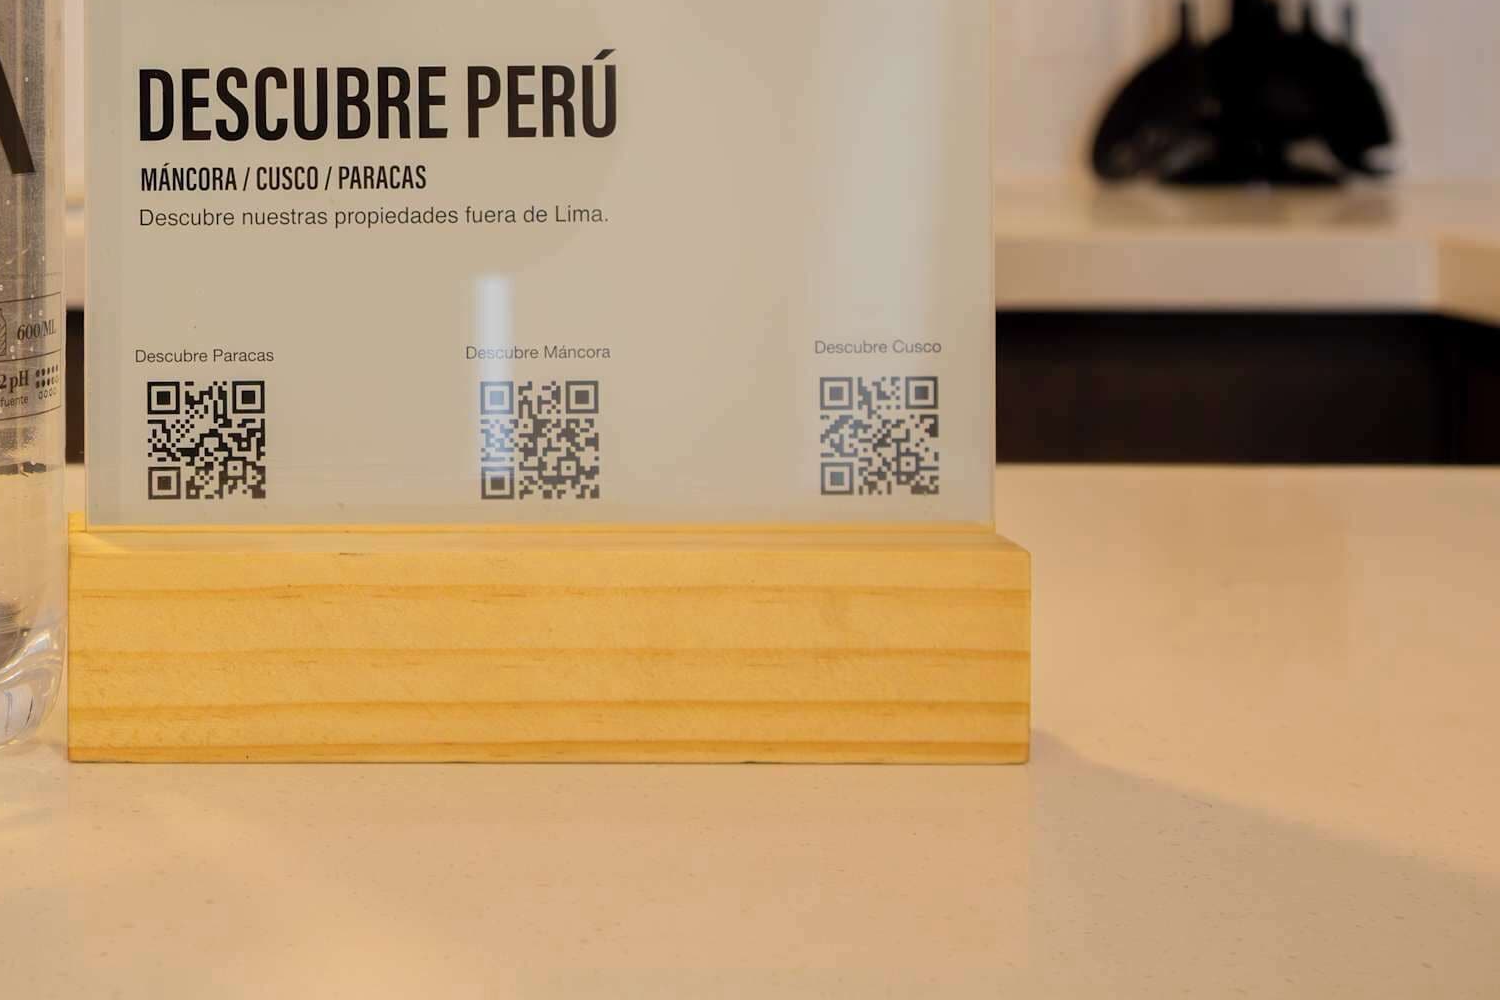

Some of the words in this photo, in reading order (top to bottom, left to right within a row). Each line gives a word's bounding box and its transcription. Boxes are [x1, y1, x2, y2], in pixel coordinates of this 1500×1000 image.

[139, 66, 449, 142] DESCUBRE
[467, 48, 617, 139] PERÚ
[140, 163, 237, 191] MÁNCORA
[256, 166, 319, 191] CUSCO
[338, 164, 427, 190] PARACAS
[139, 207, 235, 226] Descubre
[242, 208, 328, 226] nuestras
[334, 205, 459, 228] propiedades
[465, 205, 517, 224] fuera
[523, 205, 549, 223] de
[555, 204, 609, 223] Lima.
[16, 319, 57, 341] 600/ML
[134, 348, 208, 363] Descubre
[212, 347, 275, 363] Paracas
[465, 344, 539, 360] Descubre
[543, 343, 611, 359] Máncora
[814, 339, 888, 354] Descubre
[891, 339, 942, 354] Cusco
[9, 370, 29, 394] pH
